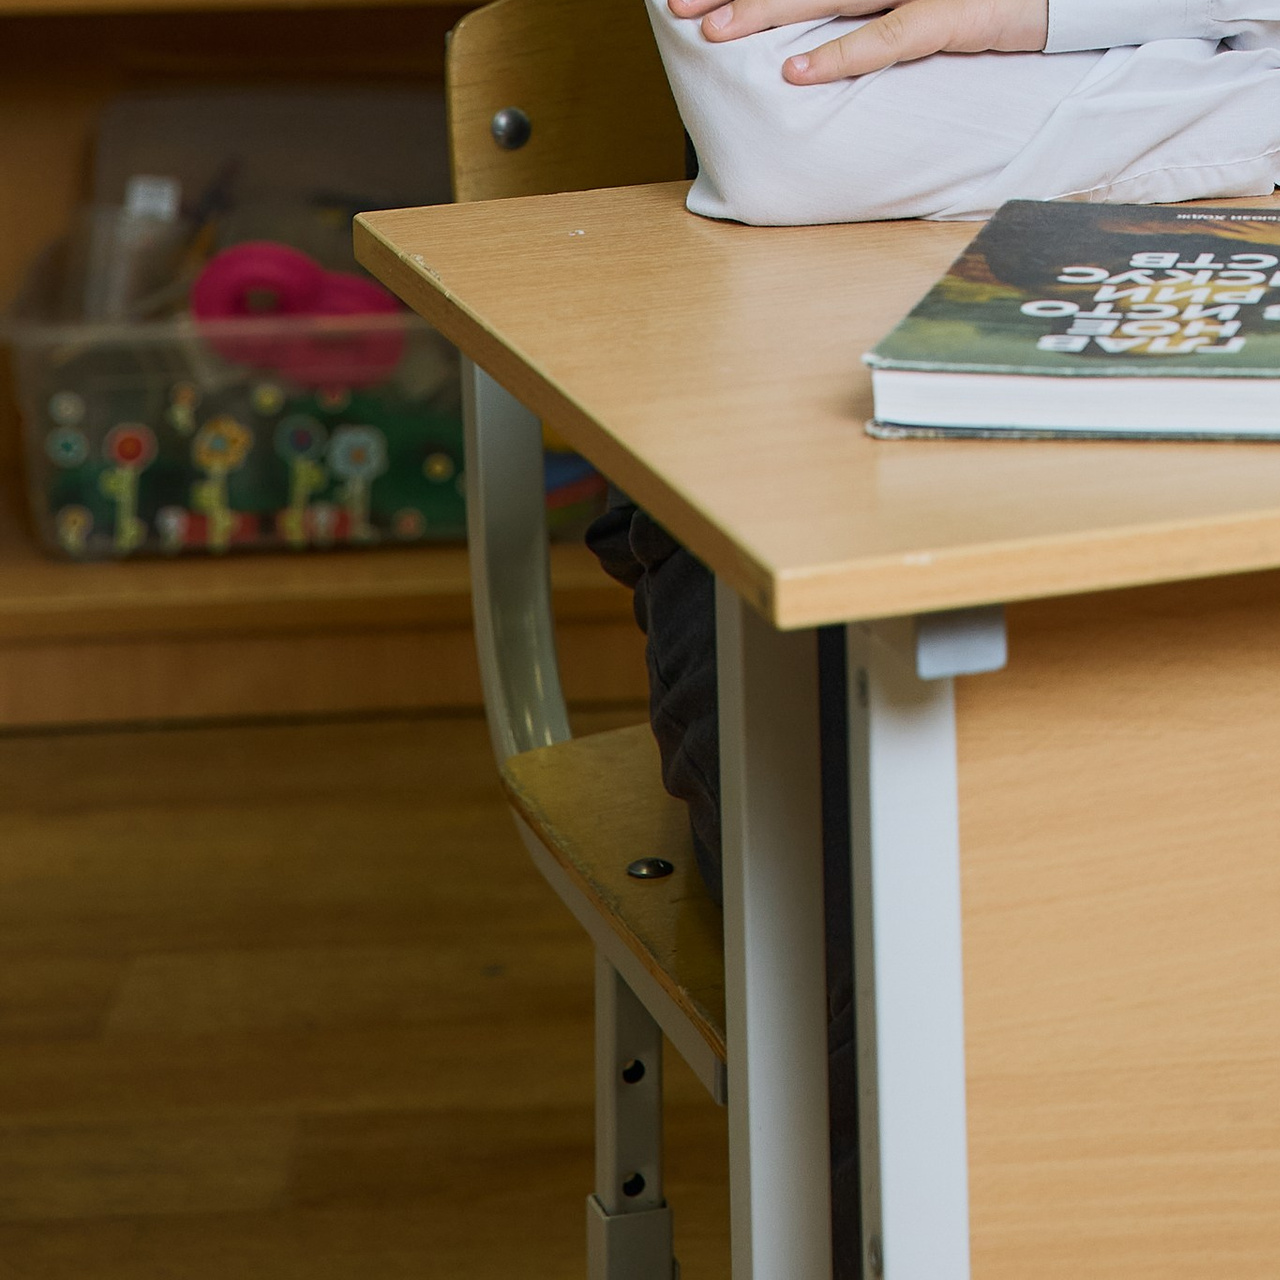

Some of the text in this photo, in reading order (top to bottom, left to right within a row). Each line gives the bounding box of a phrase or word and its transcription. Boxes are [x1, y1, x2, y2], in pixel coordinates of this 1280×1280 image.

[1128, 251, 1279, 271] СТВ
[1092, 284, 1267, 305] РИИ
[1019, 299, 1241, 321] ИСТО
[1066, 318, 1243, 338] НОЕ
[1036, 334, 1247, 354] ГЛАВ
